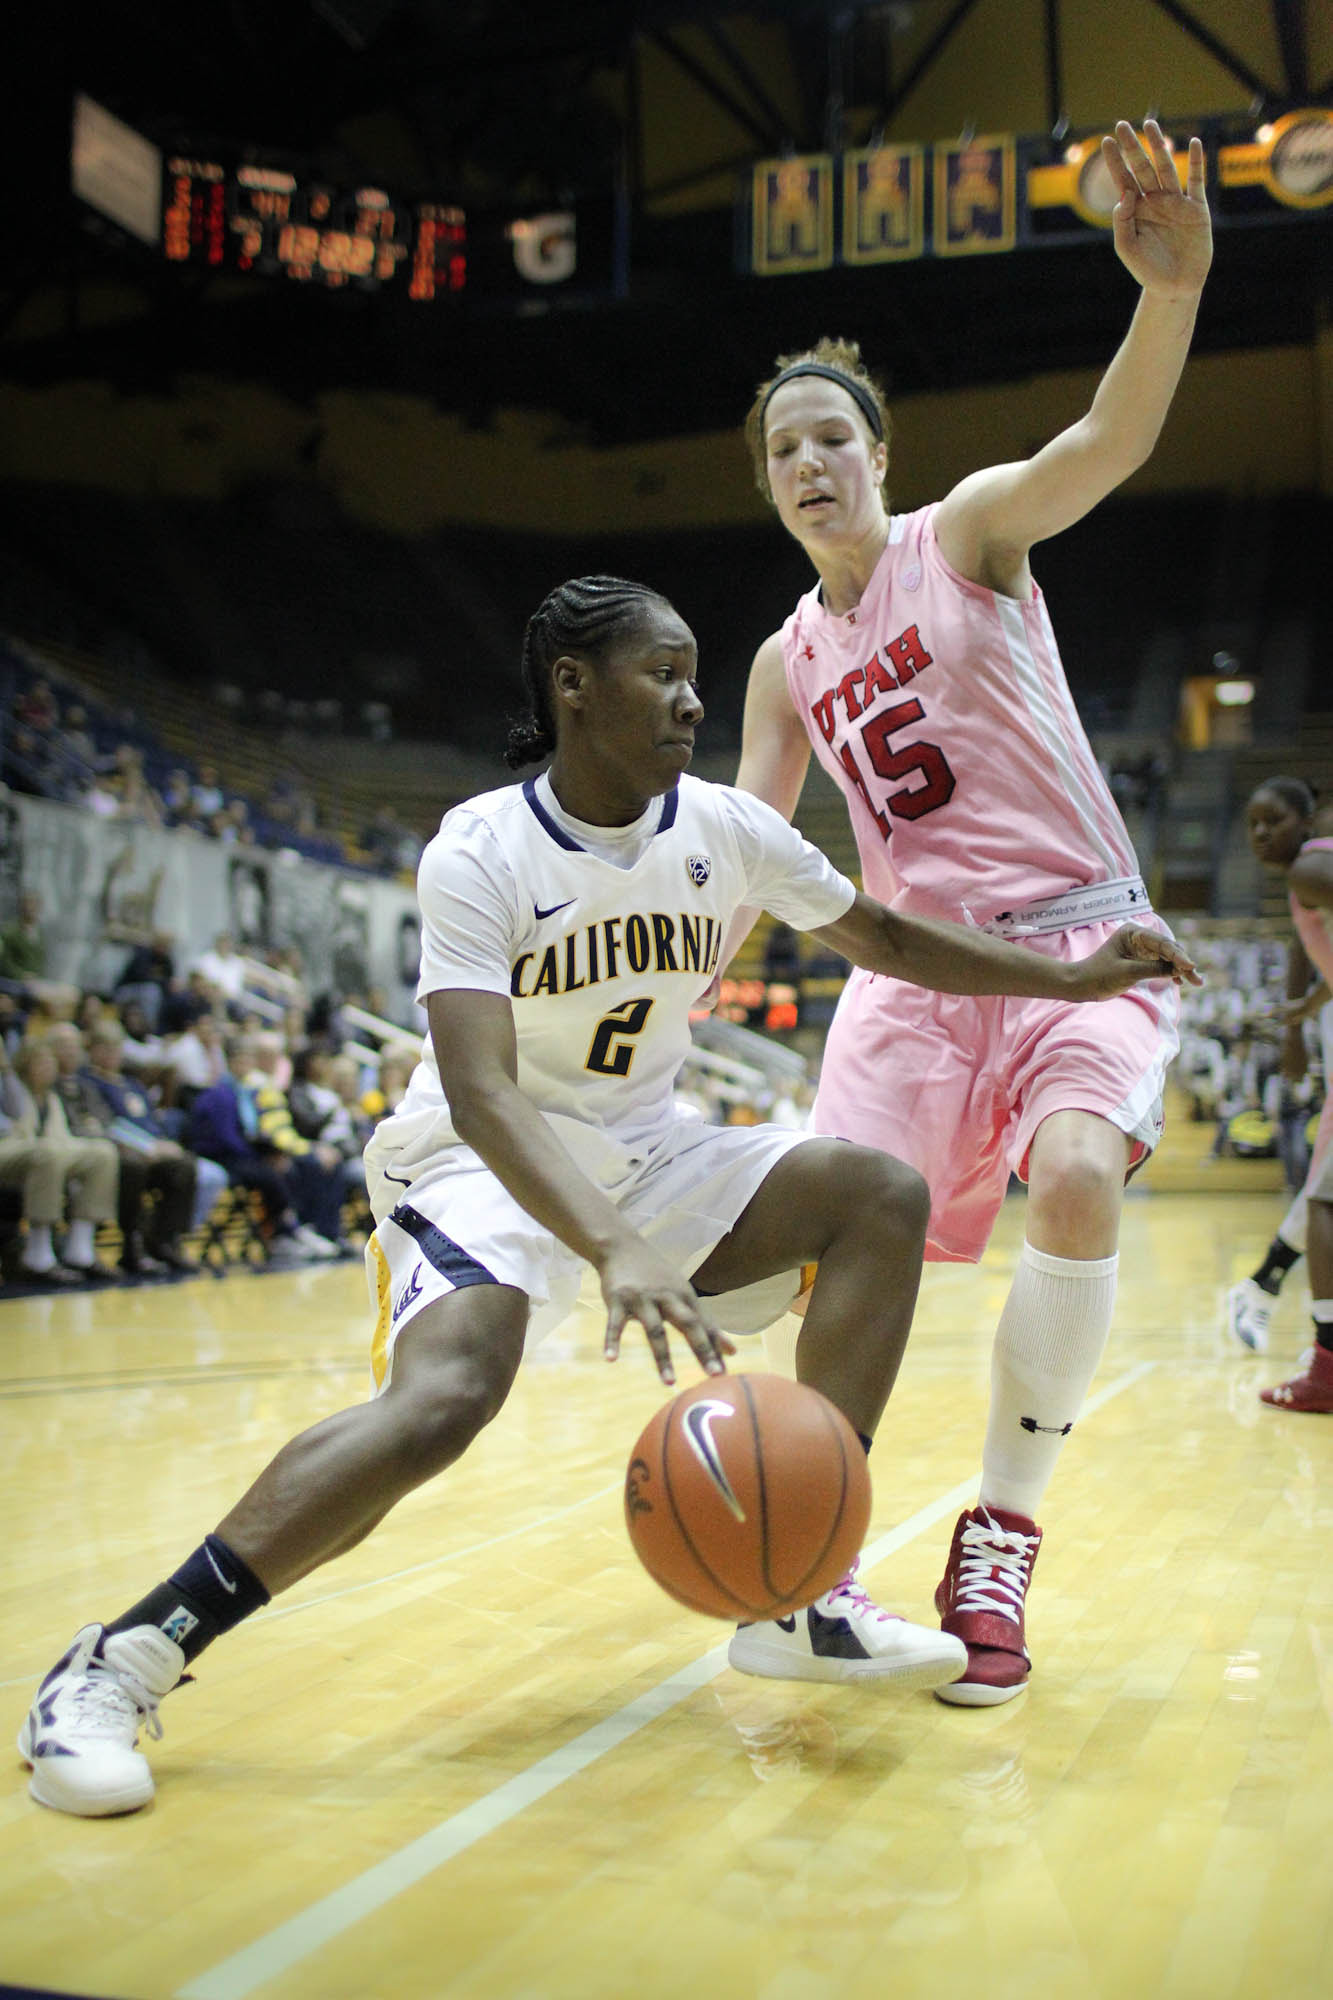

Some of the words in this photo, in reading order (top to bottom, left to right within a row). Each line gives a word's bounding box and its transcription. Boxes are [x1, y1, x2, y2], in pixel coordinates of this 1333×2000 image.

[811, 623, 934, 746] UTAH
[840, 697, 957, 843] 15
[692, 868, 706, 881] 12
[1020, 903, 1078, 922] ARMOUR
[1083, 894, 1126, 911] UNDER
[510, 912, 722, 998] CALIFORNIA
[584, 996, 656, 1079] 2
